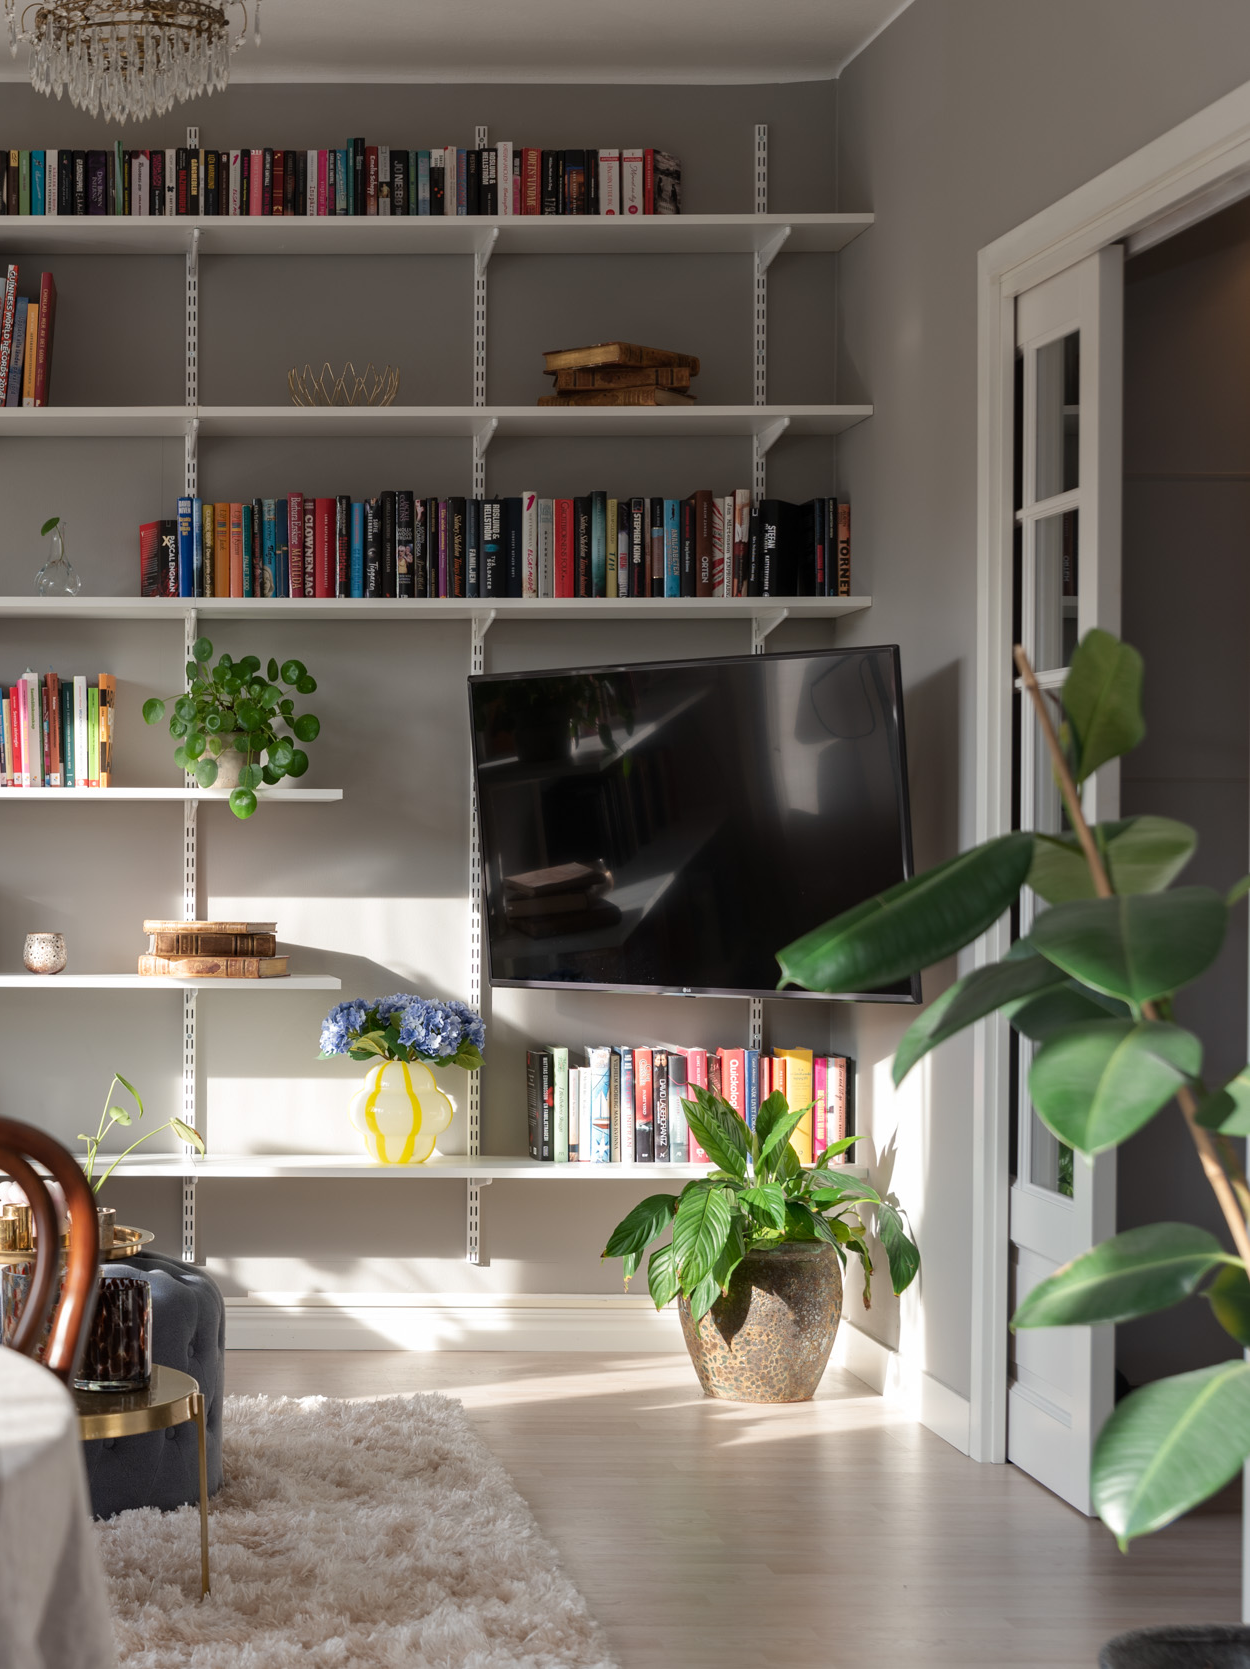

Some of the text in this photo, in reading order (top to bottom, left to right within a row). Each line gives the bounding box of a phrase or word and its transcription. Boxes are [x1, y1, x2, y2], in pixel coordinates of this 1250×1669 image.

[367, 175, 377, 195] Schepp
[394, 161, 403, 173] JO
[527, 176, 536, 206] VINDAR
[545, 198, 556, 215] 1793
[6, 270, 16, 310] GUINNESS
[3, 312, 12, 339] WORLD
[0, 340, 8, 377] RECORDS
[484, 504, 492, 540] HELLSTRÖM
[492, 504, 500, 533] ROSLUND
[768, 525, 776, 548] STEFAN
[291, 497, 301, 589] Barbara Erskine MATILDA
[304, 514, 313, 596] CLOWNEN JAC
[633, 513, 641, 564] STEPHEN KING
[671, 529, 680, 576] ANALFABETEN
[366, 561, 378, 590] Tiggaren
[840, 537, 849, 596] TORNET
[729, 1059, 739, 1109] Quickologi
